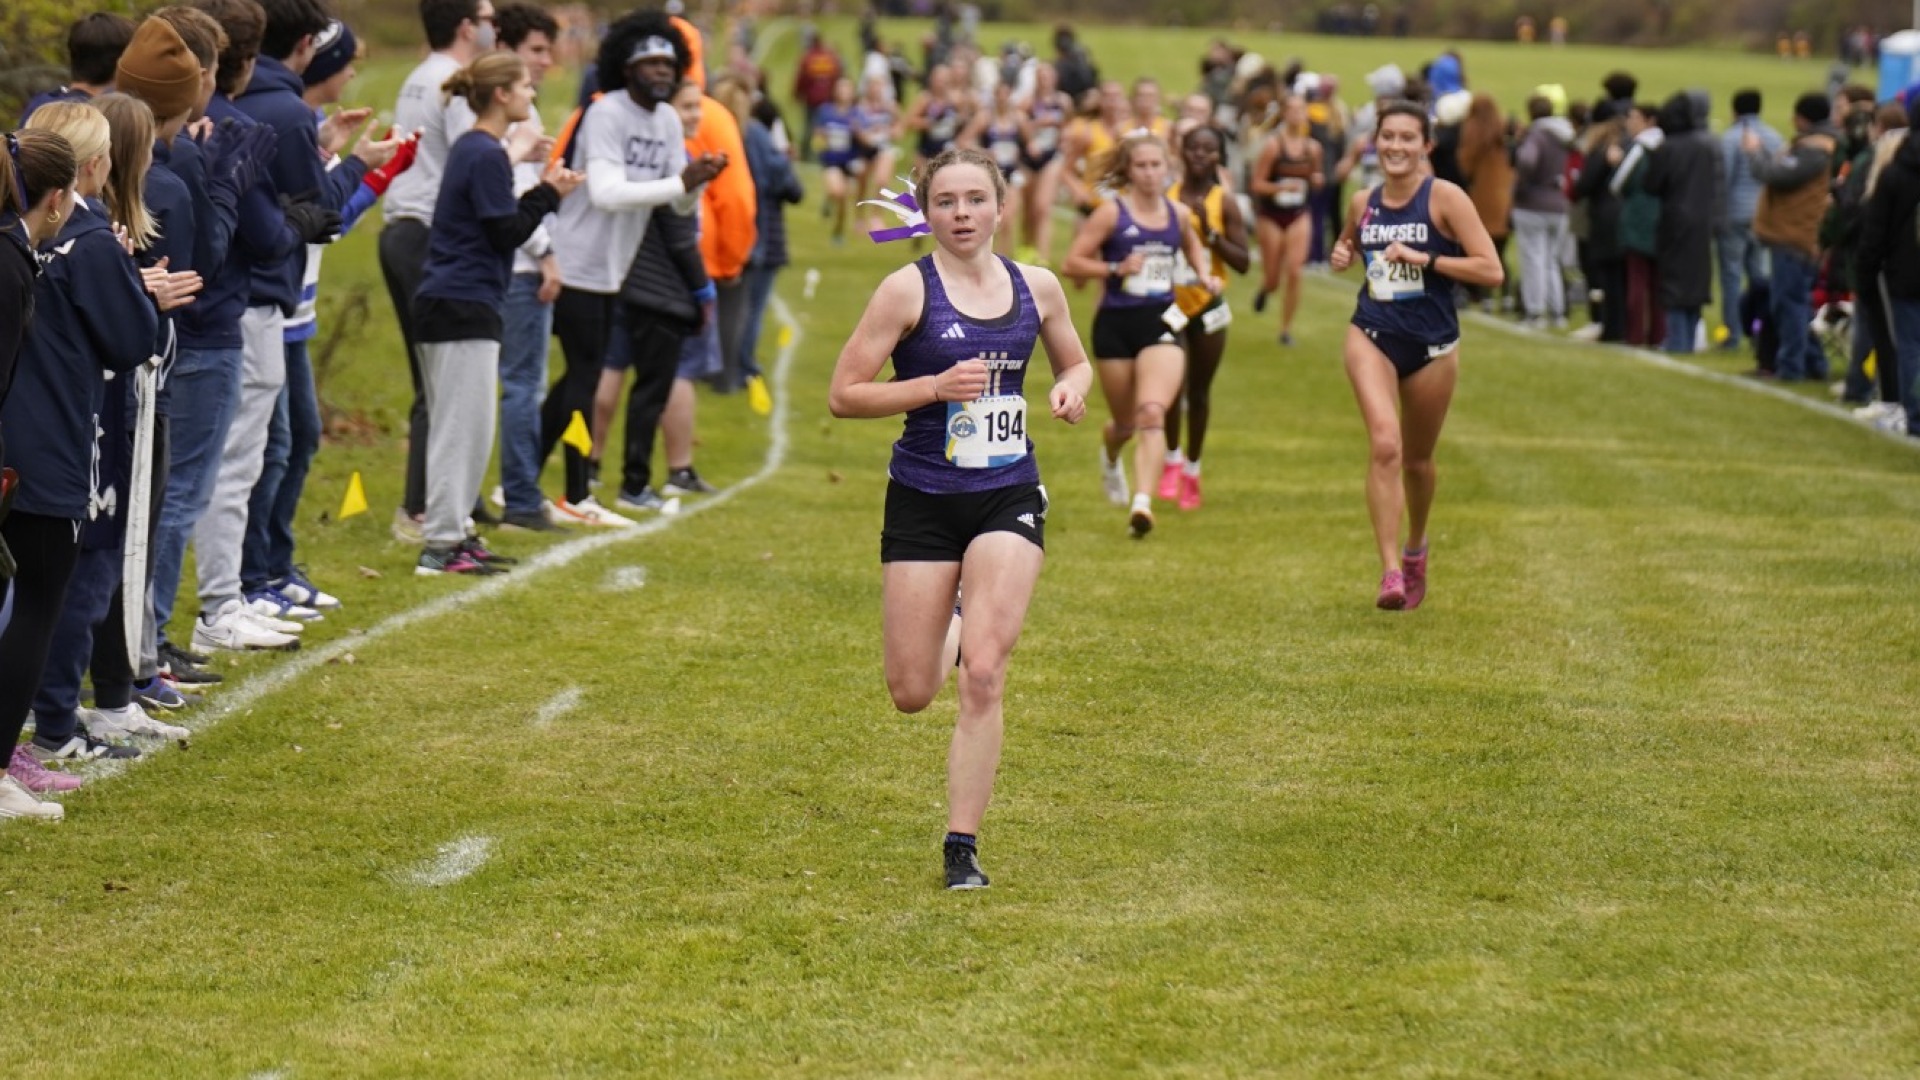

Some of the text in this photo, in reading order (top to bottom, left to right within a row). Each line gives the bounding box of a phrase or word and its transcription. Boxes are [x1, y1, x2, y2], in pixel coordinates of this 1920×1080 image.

[1361, 223, 1428, 244] GENESEO
[1388, 262, 1420, 281] 246
[984, 409, 1024, 442] 194
